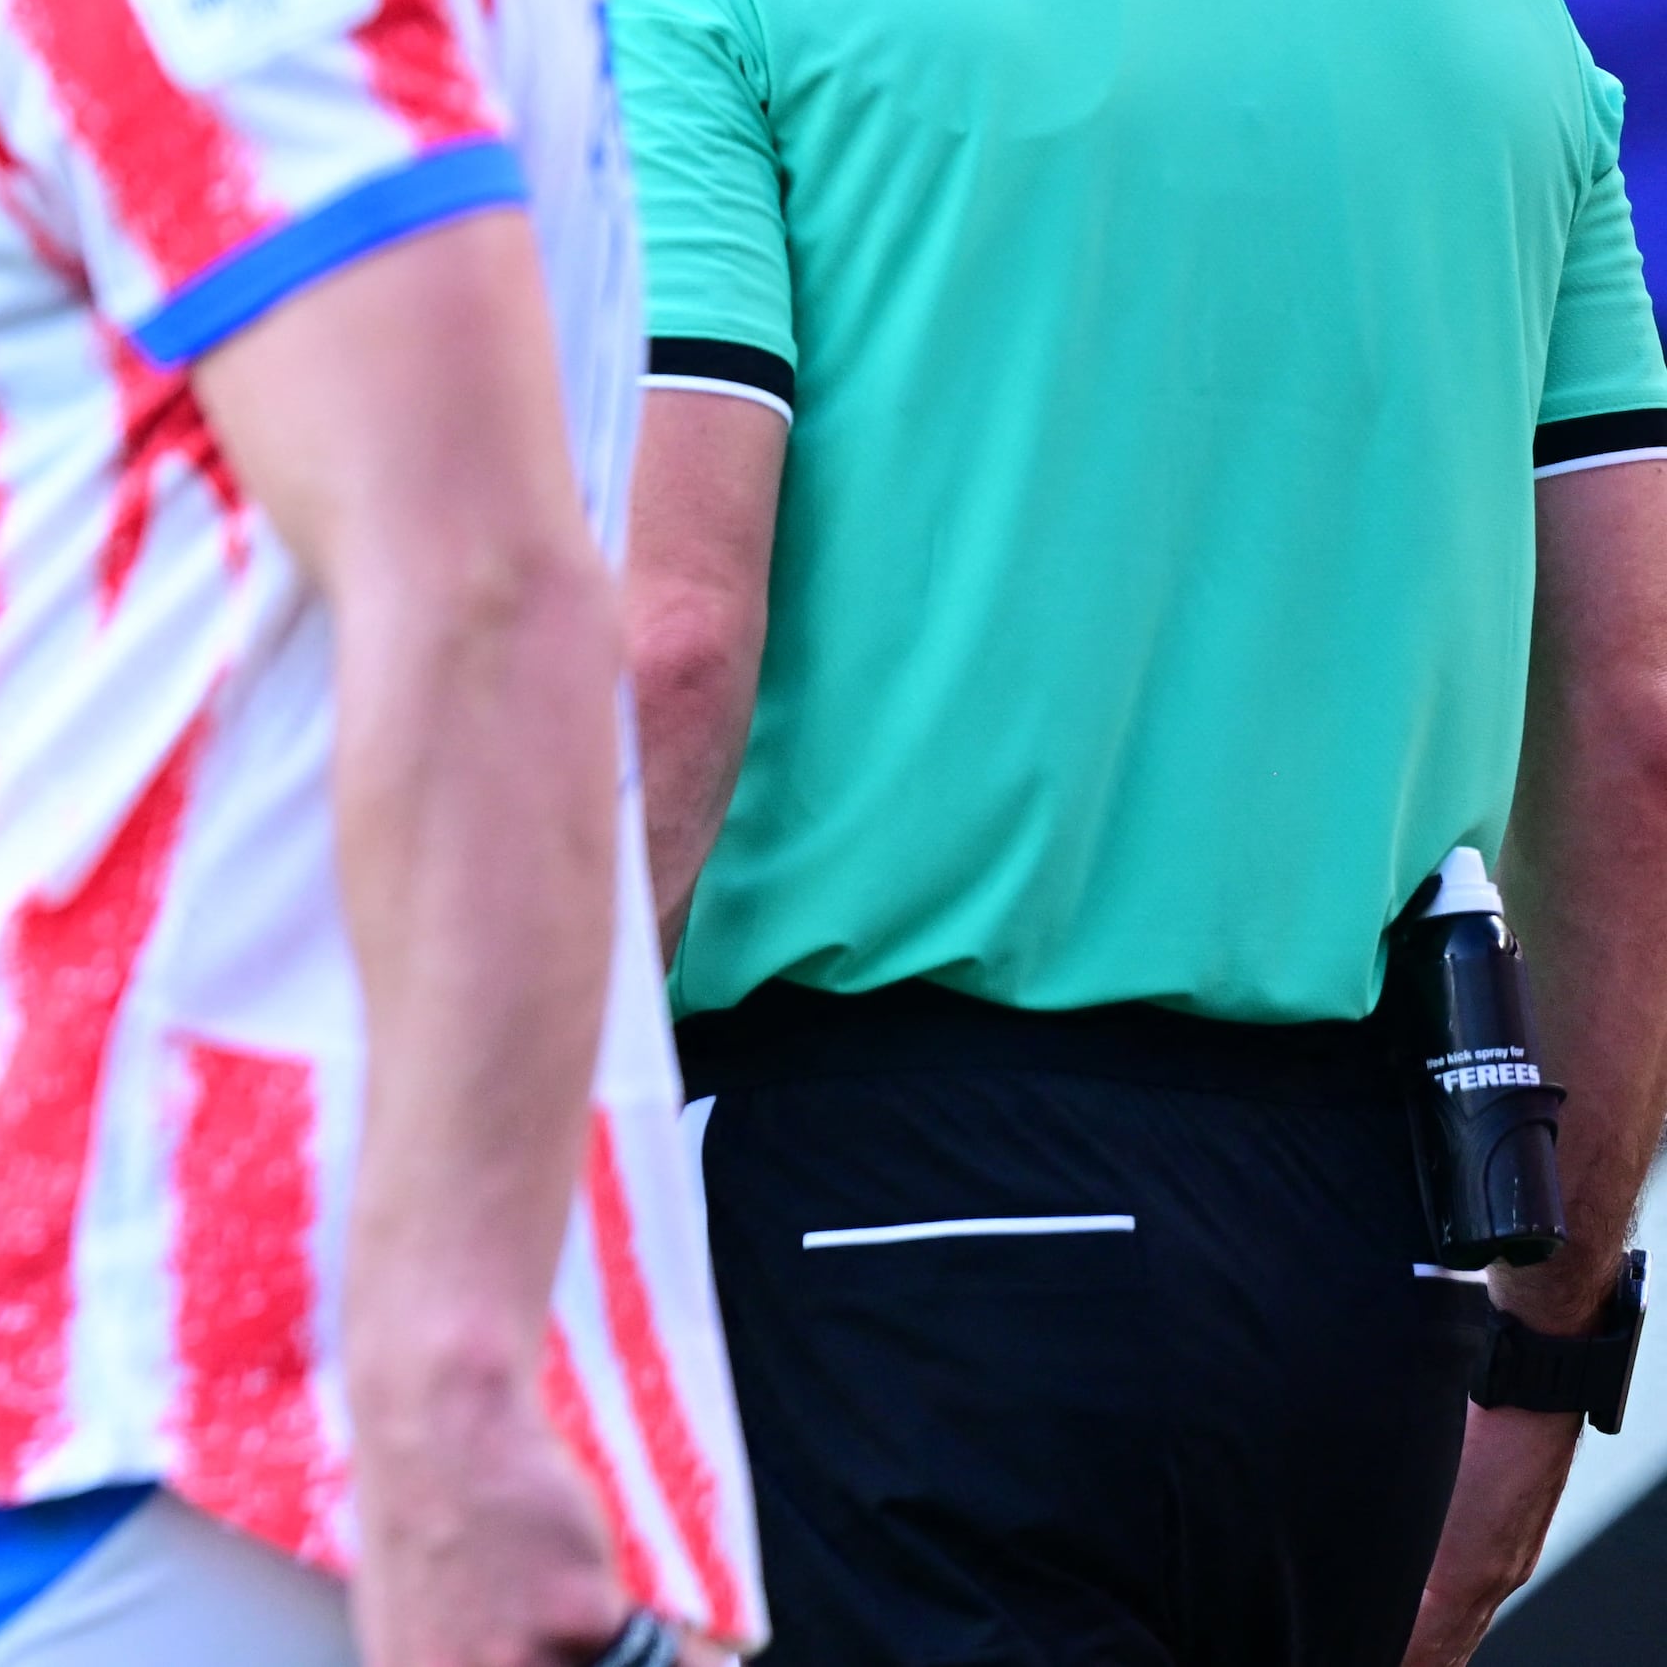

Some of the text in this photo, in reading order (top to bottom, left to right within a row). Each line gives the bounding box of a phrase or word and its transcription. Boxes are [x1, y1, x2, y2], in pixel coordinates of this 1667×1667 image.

[1447, 1049, 1472, 1065] kick
[1475, 1047, 1508, 1062] spray
[1510, 1045, 1525, 1058] for
[1434, 1062, 1540, 1093] FEREES
